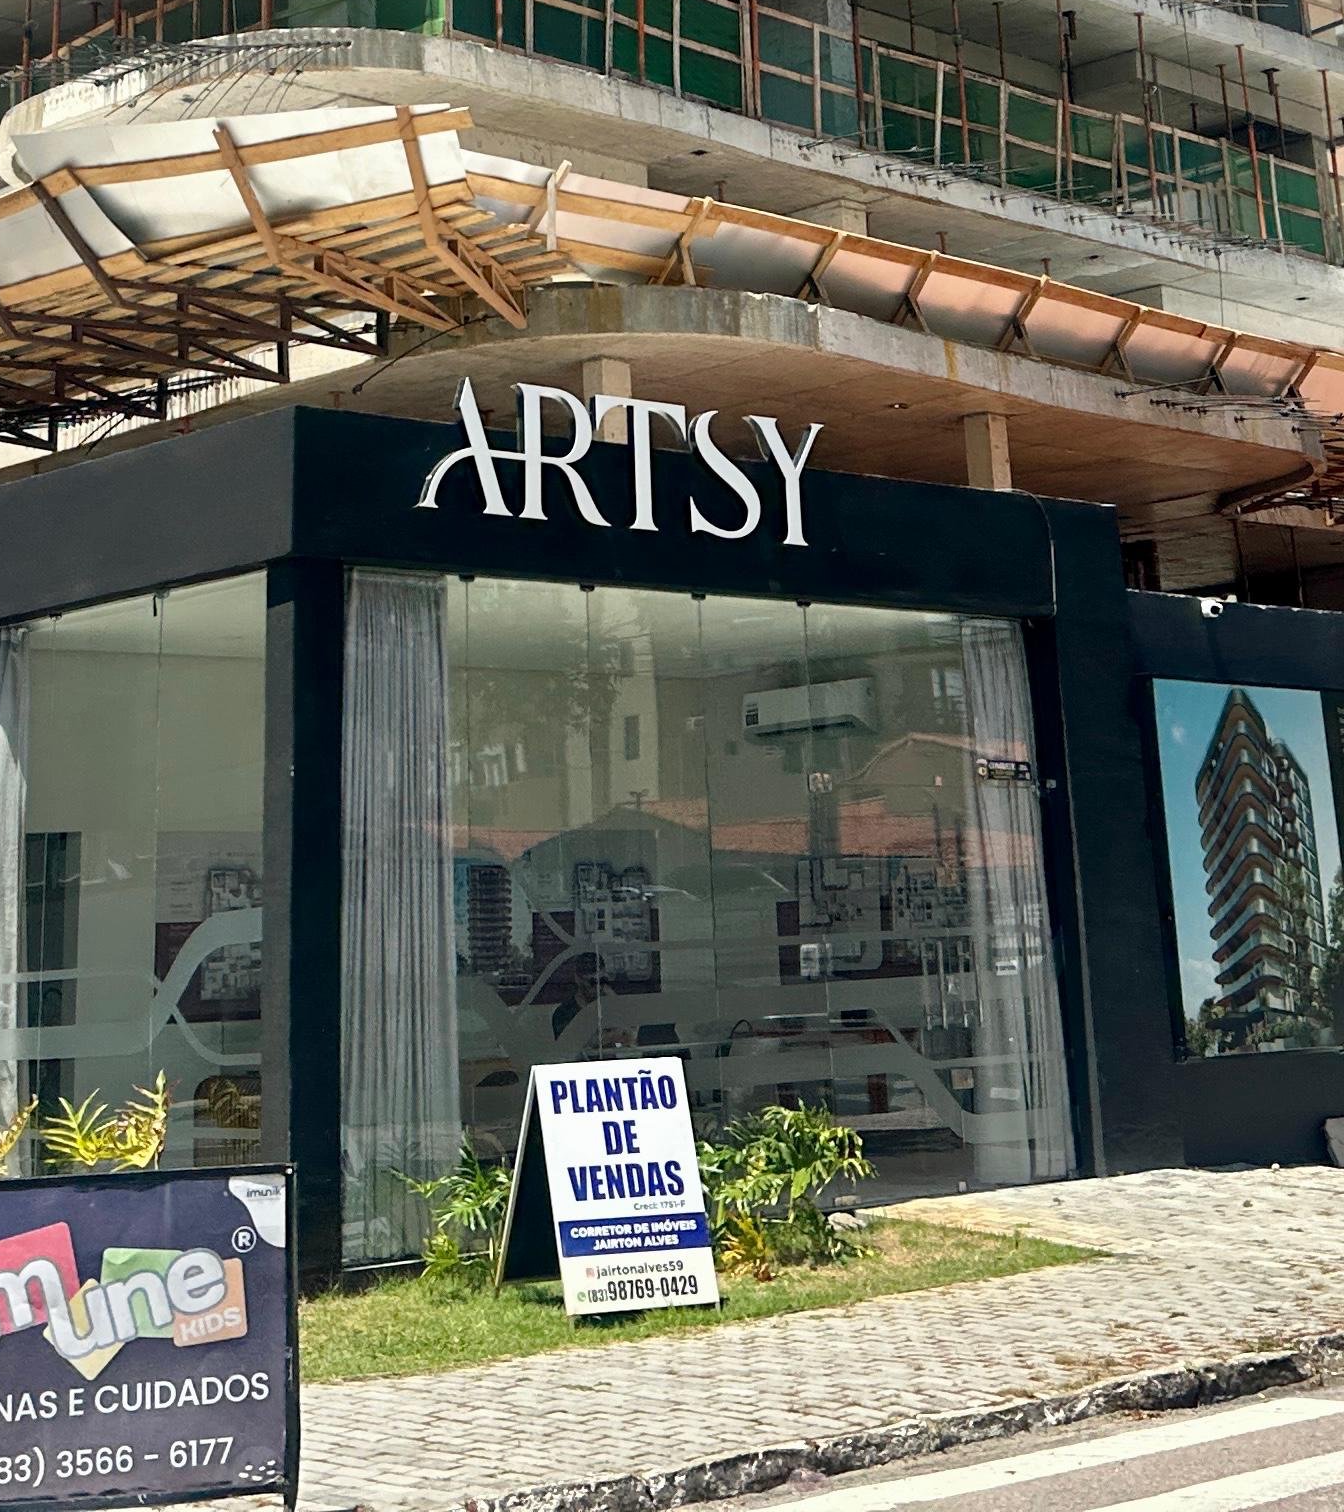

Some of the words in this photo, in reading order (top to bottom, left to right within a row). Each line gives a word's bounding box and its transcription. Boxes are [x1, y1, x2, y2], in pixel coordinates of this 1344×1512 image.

[413, 376, 825, 546] ARTSY
[550, 1069, 678, 1115] PLANTÃO
[602, 1120, 641, 1156] DE
[567, 1160, 685, 1202] VENDAS
[570, 1224, 632, 1238] CORRETOR
[634, 1222, 650, 1234] DE
[651, 1219, 697, 1233] IMÓVEIS
[593, 1237, 642, 1251] JAIRTON
[644, 1234, 679, 1247] ALVES
[596, 1260, 684, 1279] jairtonalves59
[179, 1306, 242, 1341] KIDS
[68, 1387, 85, 1417] E
[94, 1372, 270, 1415] CUIDADOS
[56, 1445, 134, 1478] 3566
[169, 1436, 234, 1468] 6177
